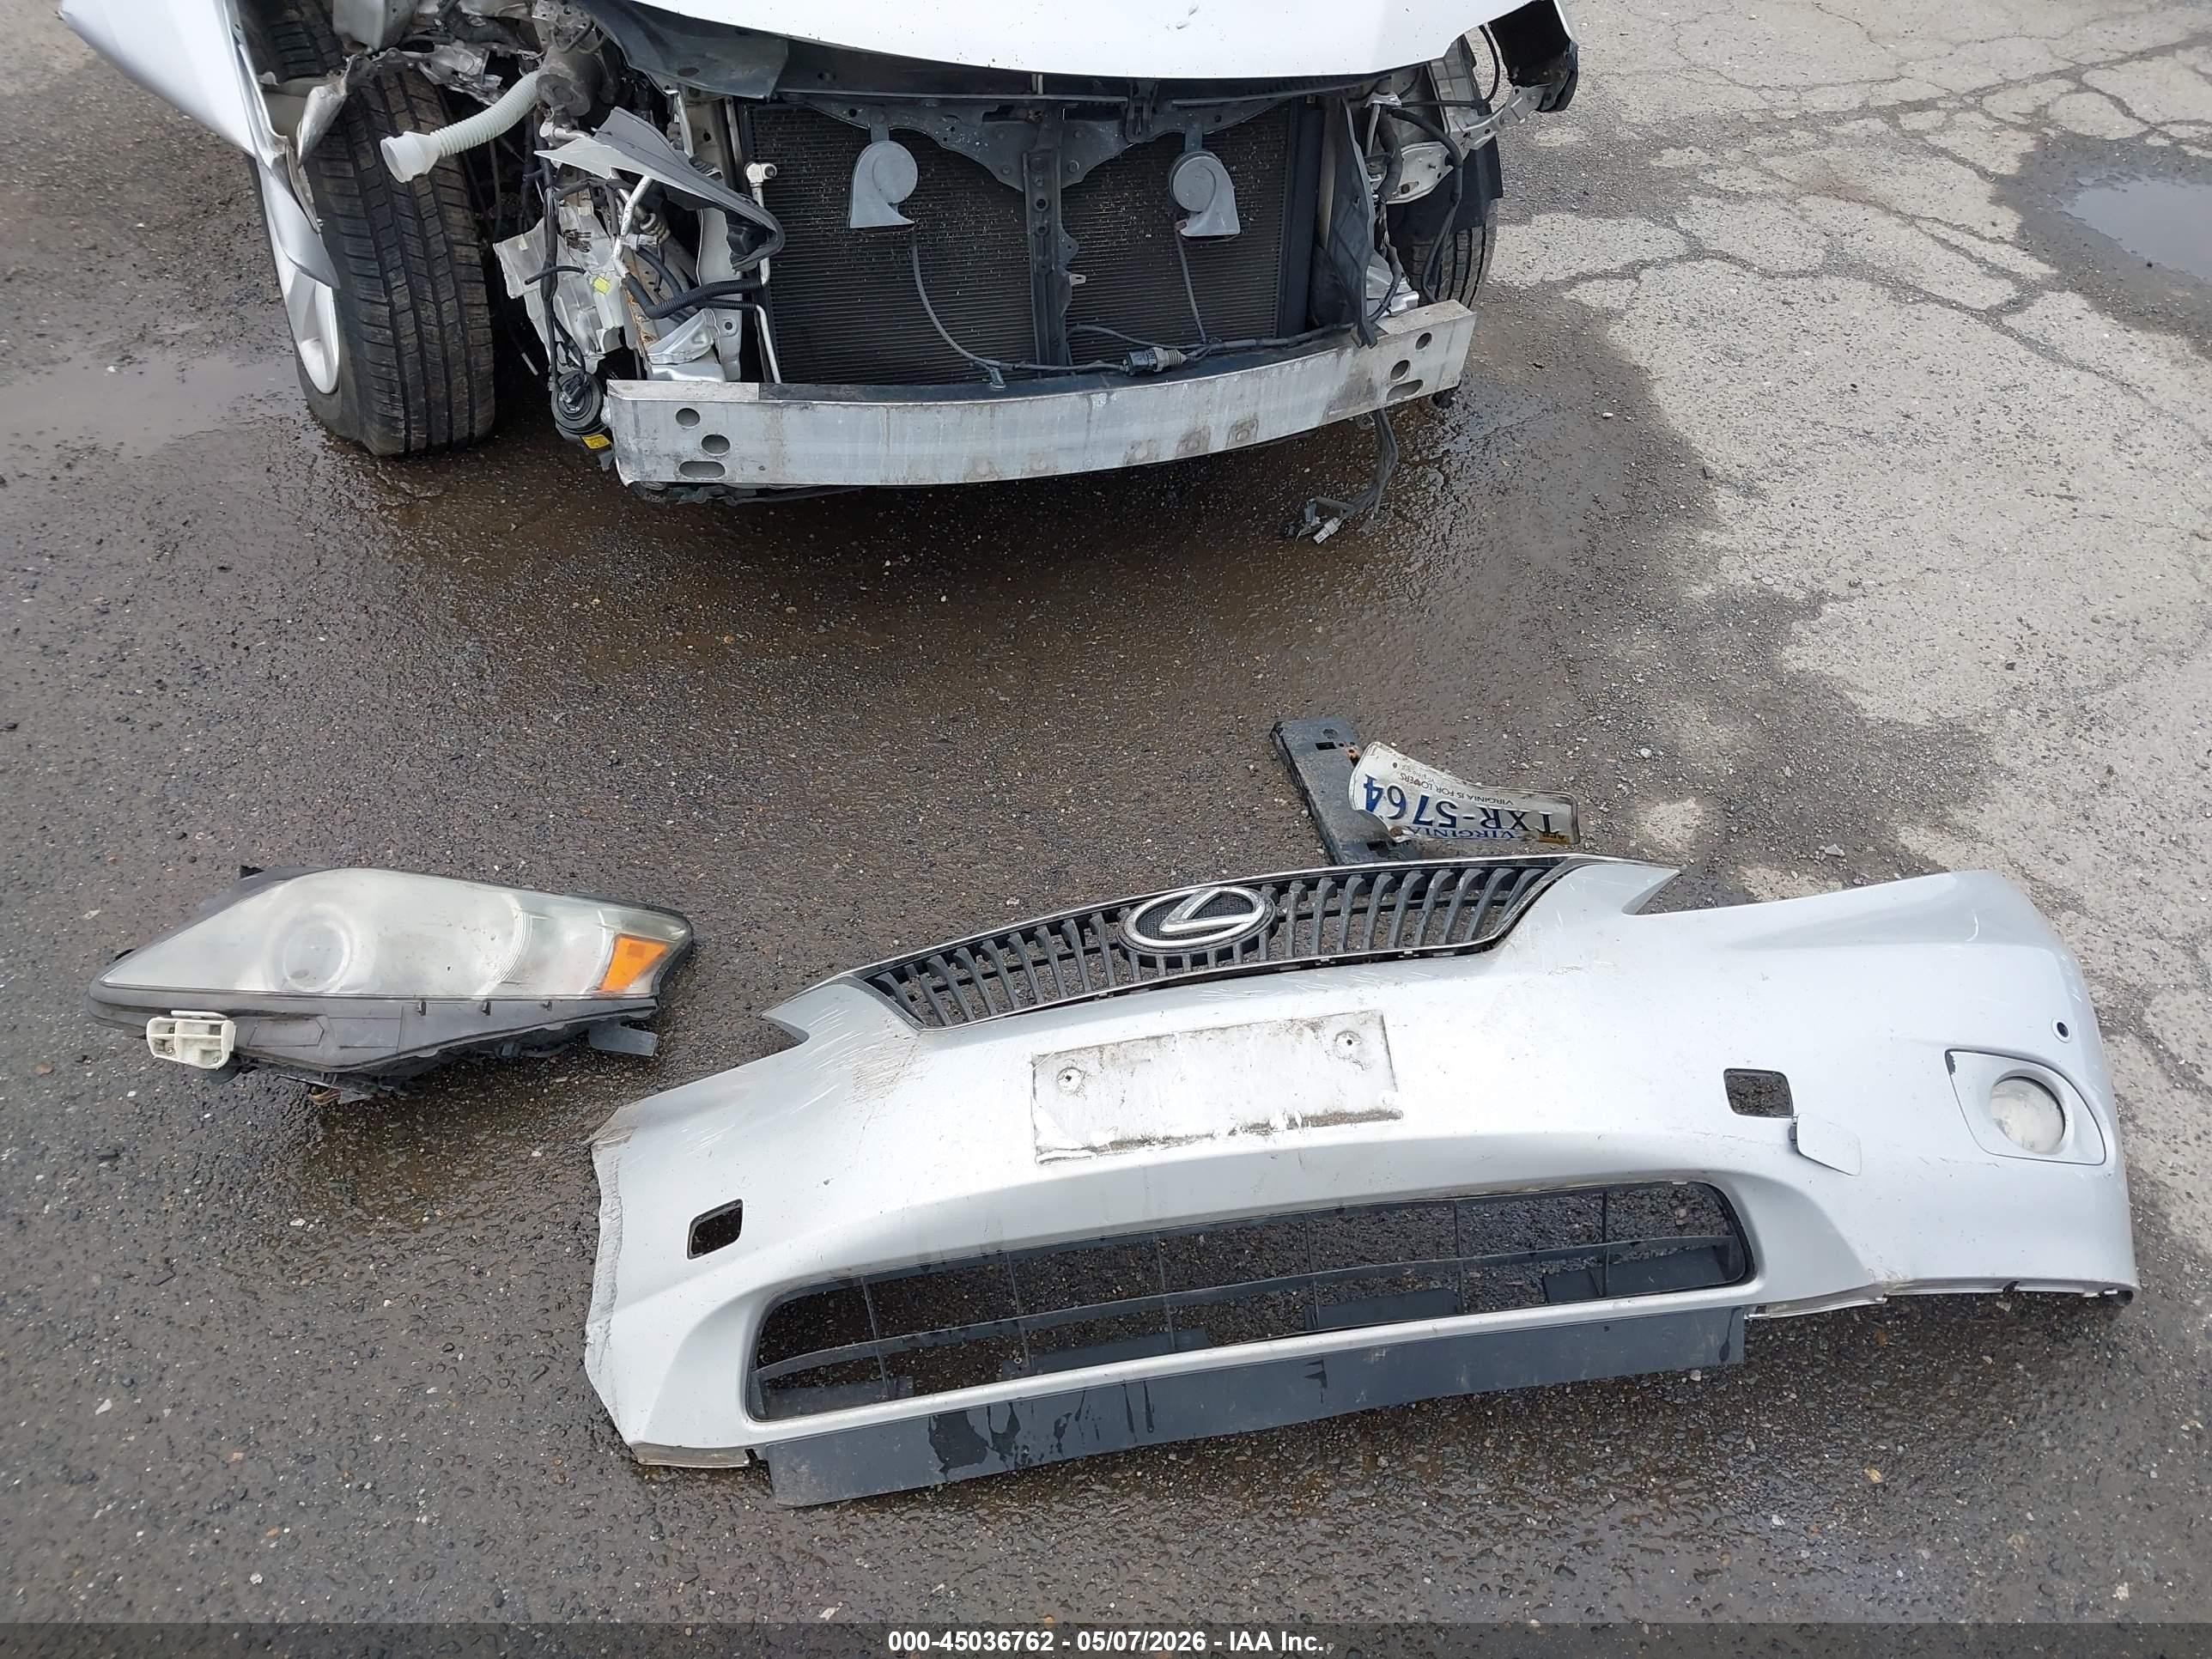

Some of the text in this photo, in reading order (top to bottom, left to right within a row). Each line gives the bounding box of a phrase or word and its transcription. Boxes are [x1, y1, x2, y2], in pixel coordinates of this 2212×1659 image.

[1436, 786, 1454, 797] FOR
[1364, 774, 1562, 835] TXR-5764
[1467, 793, 1514, 805] VIRGINIA
[1405, 825, 1516, 840] VIRGINIA
